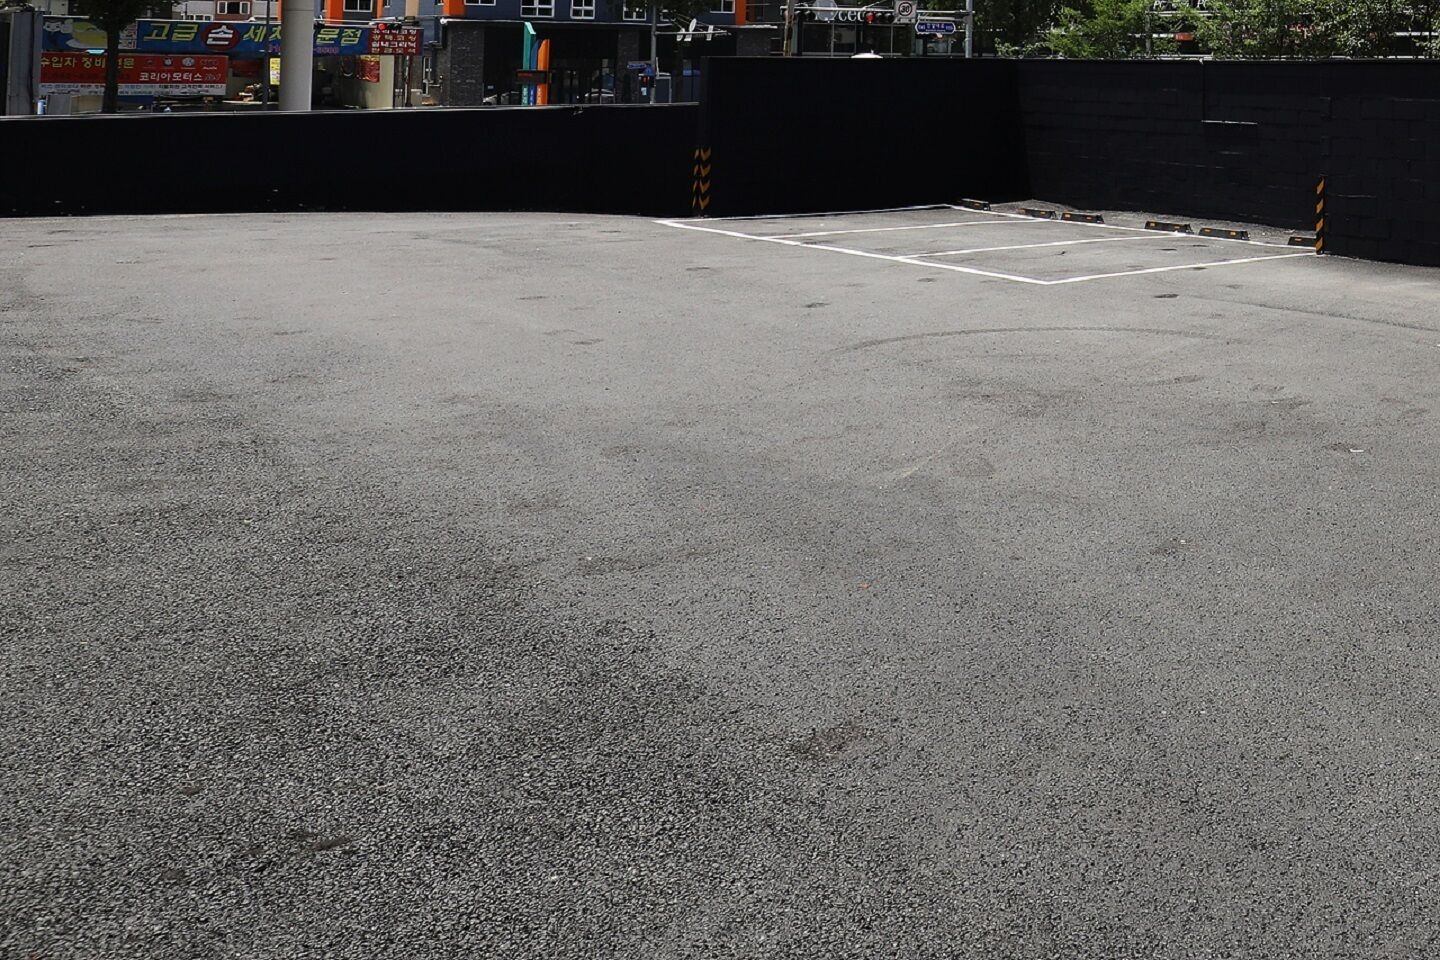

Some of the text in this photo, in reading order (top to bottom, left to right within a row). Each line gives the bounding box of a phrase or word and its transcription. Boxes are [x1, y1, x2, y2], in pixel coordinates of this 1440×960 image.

[901, 5, 909, 13] 30
[143, 23, 199, 43] 고급
[206, 25, 234, 45] 손
[139, 72, 203, 82] 코리아모터스
